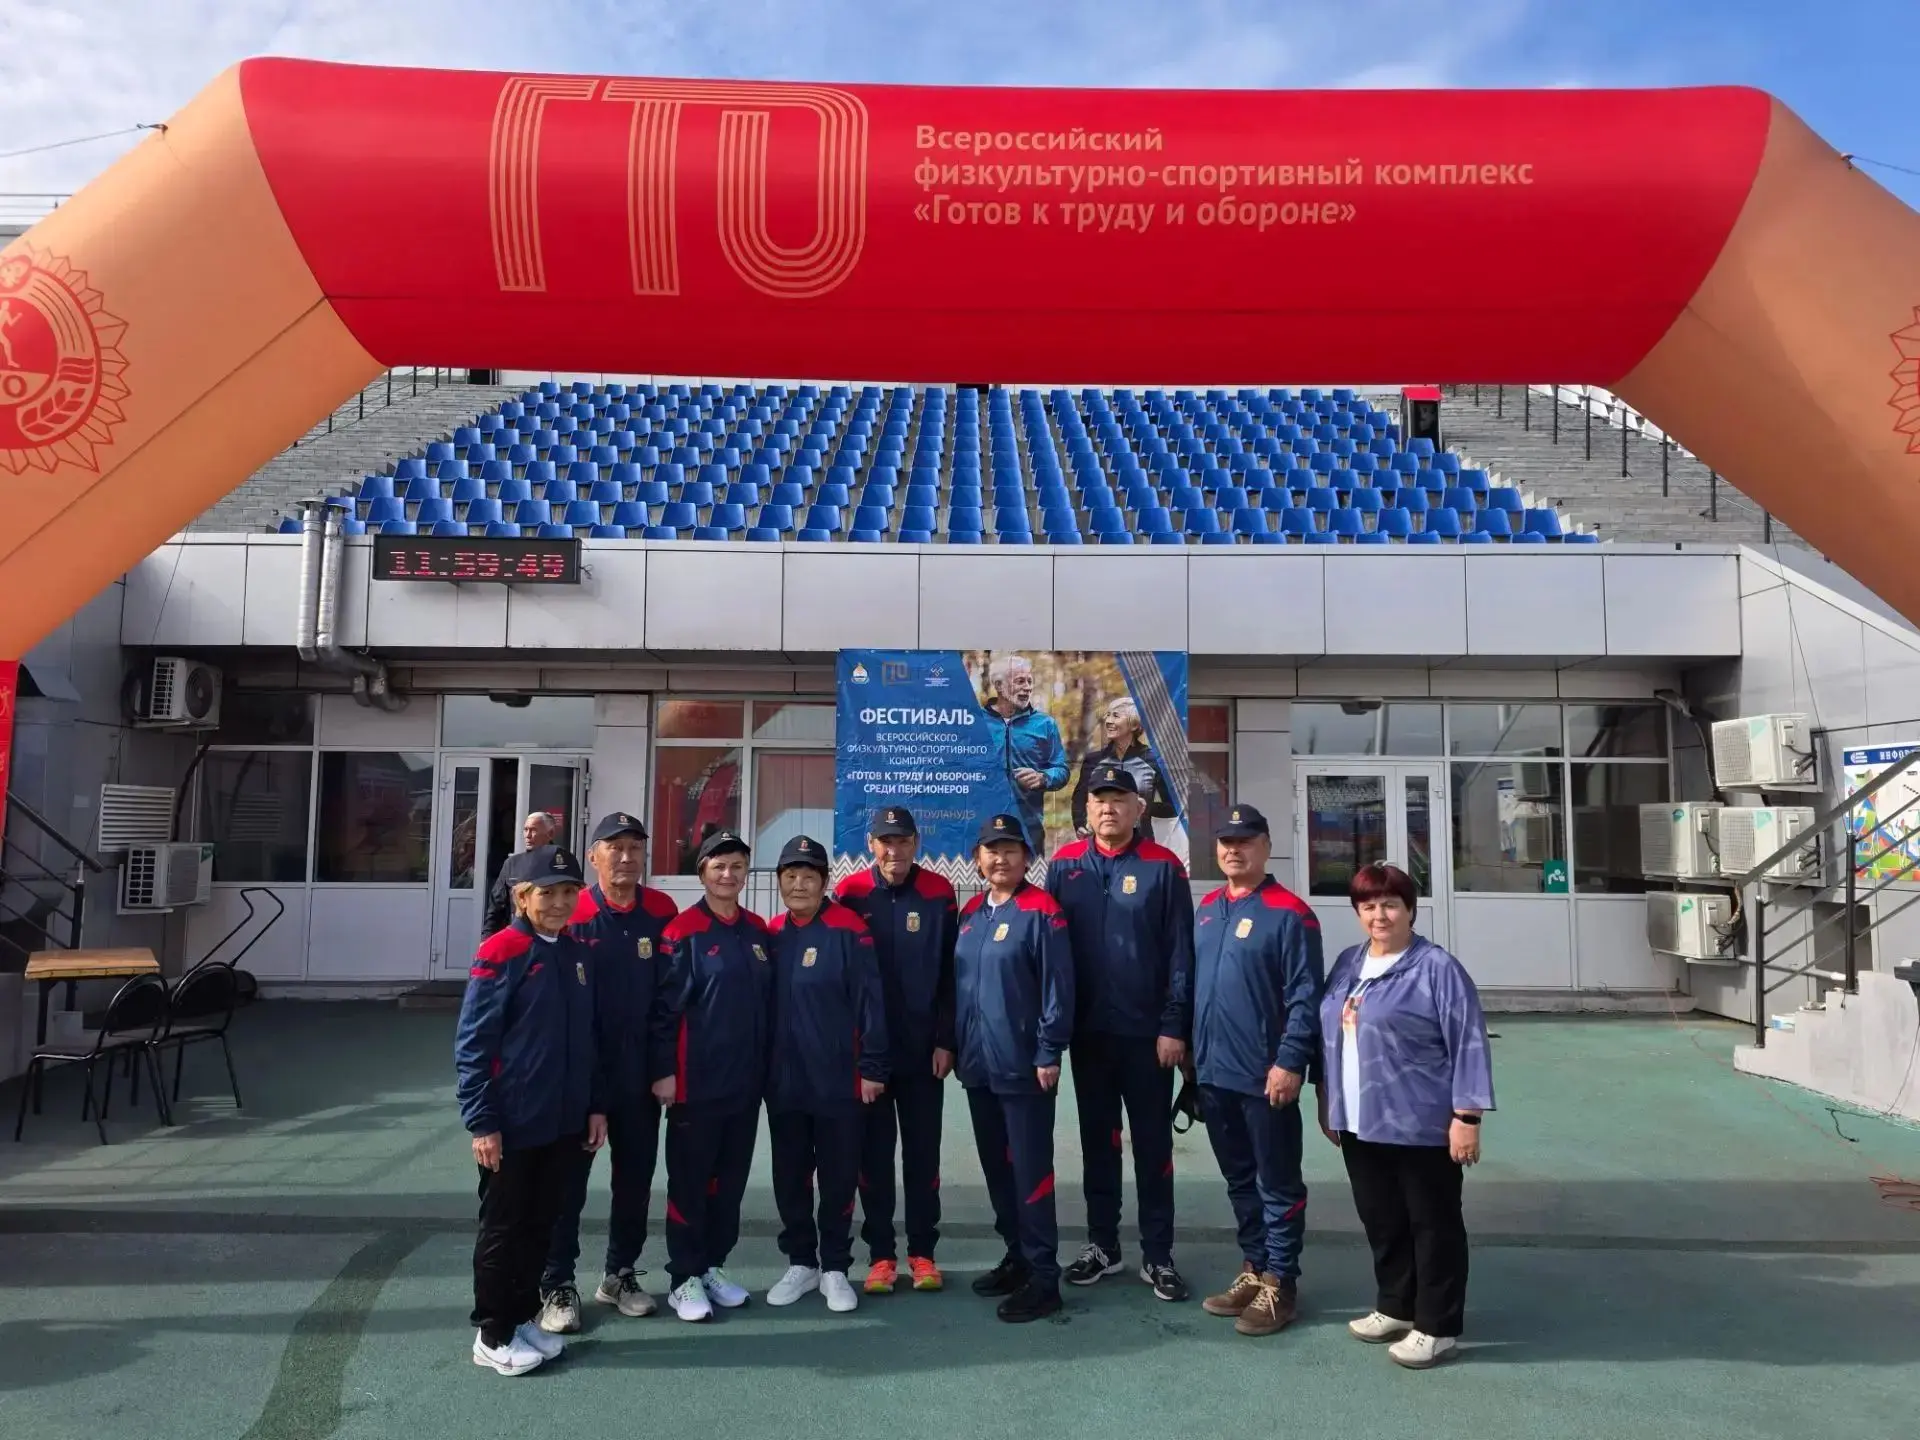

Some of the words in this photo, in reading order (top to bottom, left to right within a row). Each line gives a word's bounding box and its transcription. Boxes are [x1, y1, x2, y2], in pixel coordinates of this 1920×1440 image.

[915, 124, 1163, 156] Всероссийский
[914, 157, 1364, 192] физкультурно-спортивный
[1374, 161, 1534, 186] комплекс
[489, 76, 869, 299] ГТО
[914, 194, 1022, 226] «Готов
[1032, 200, 1049, 226] к
[1060, 200, 1155, 233] труду
[1166, 201, 1185, 226] и
[1196, 196, 1357, 234] обороне»
[389, 551, 564, 577] 11:59:49
[859, 708, 975, 725] ФЕСТИВАЛЬ
[876, 732, 958, 742] ВСЕРОССИЙСКОГО
[847, 744, 988, 755] ФИЗКУЛЬТУРНО-СПОРТИВНОГО
[1879, 749, 1914, 760] ИНФОР
[889, 756, 945, 766] КОМПЛЕКСА
[847, 771, 882, 780] «ГОТОВ
[884, 772, 891, 780] К
[893, 772, 924, 782] ТРУДУ
[926, 773, 933, 781] И
[935, 773, 987, 782] ОБОРОНЕ»
[863, 784, 896, 795] СРЕДИ
[897, 784, 970, 794] ПЕНСИОНЕРОВ
[911, 808, 977, 820] ГТОУЛАНУДЭ
